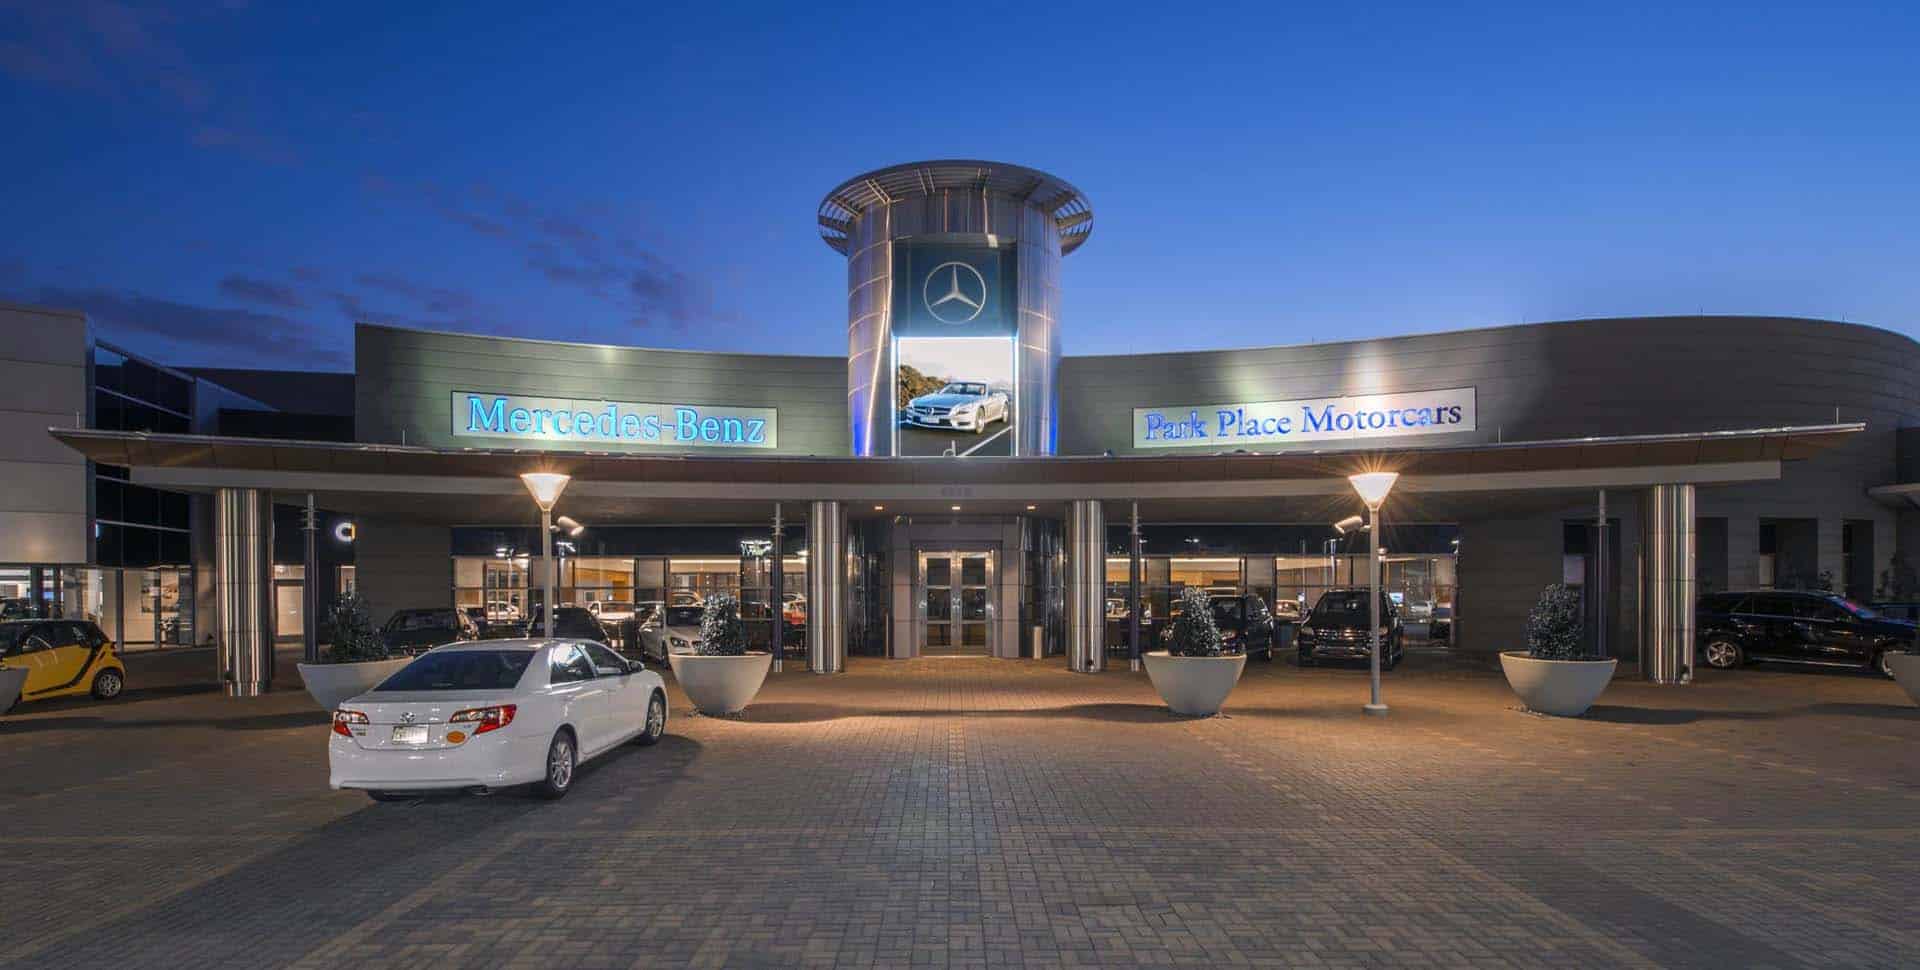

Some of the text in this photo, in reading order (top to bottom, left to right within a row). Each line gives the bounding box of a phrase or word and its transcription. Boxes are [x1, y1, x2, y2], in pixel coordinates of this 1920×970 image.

[466, 396, 766, 444] Mercedes-Benz
[1144, 402, 1462, 440] Park Place Motorcars
